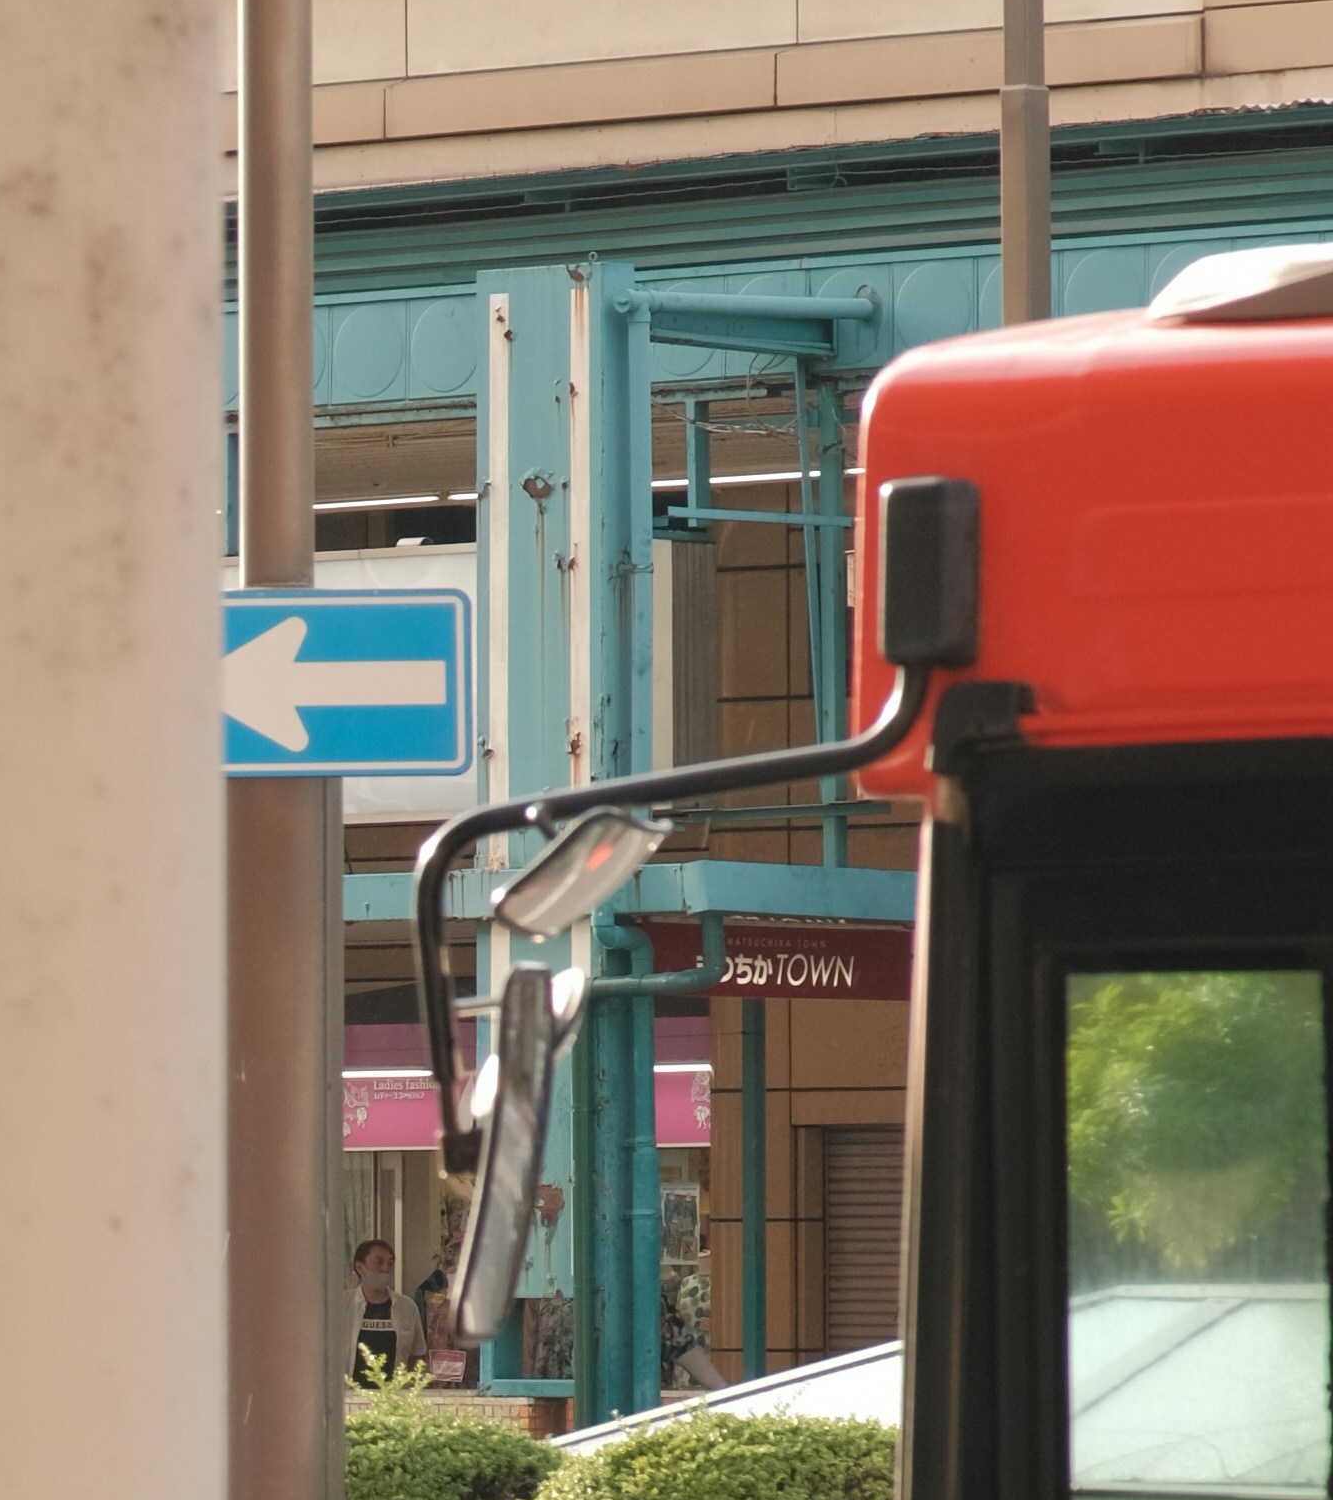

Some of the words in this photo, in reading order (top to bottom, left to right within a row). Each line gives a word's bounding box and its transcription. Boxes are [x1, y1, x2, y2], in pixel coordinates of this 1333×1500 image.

[373, 1078, 404, 1090] Ladies
[405, 1078, 440, 1090] fashio
[362, 1320, 393, 1329] GUESS
